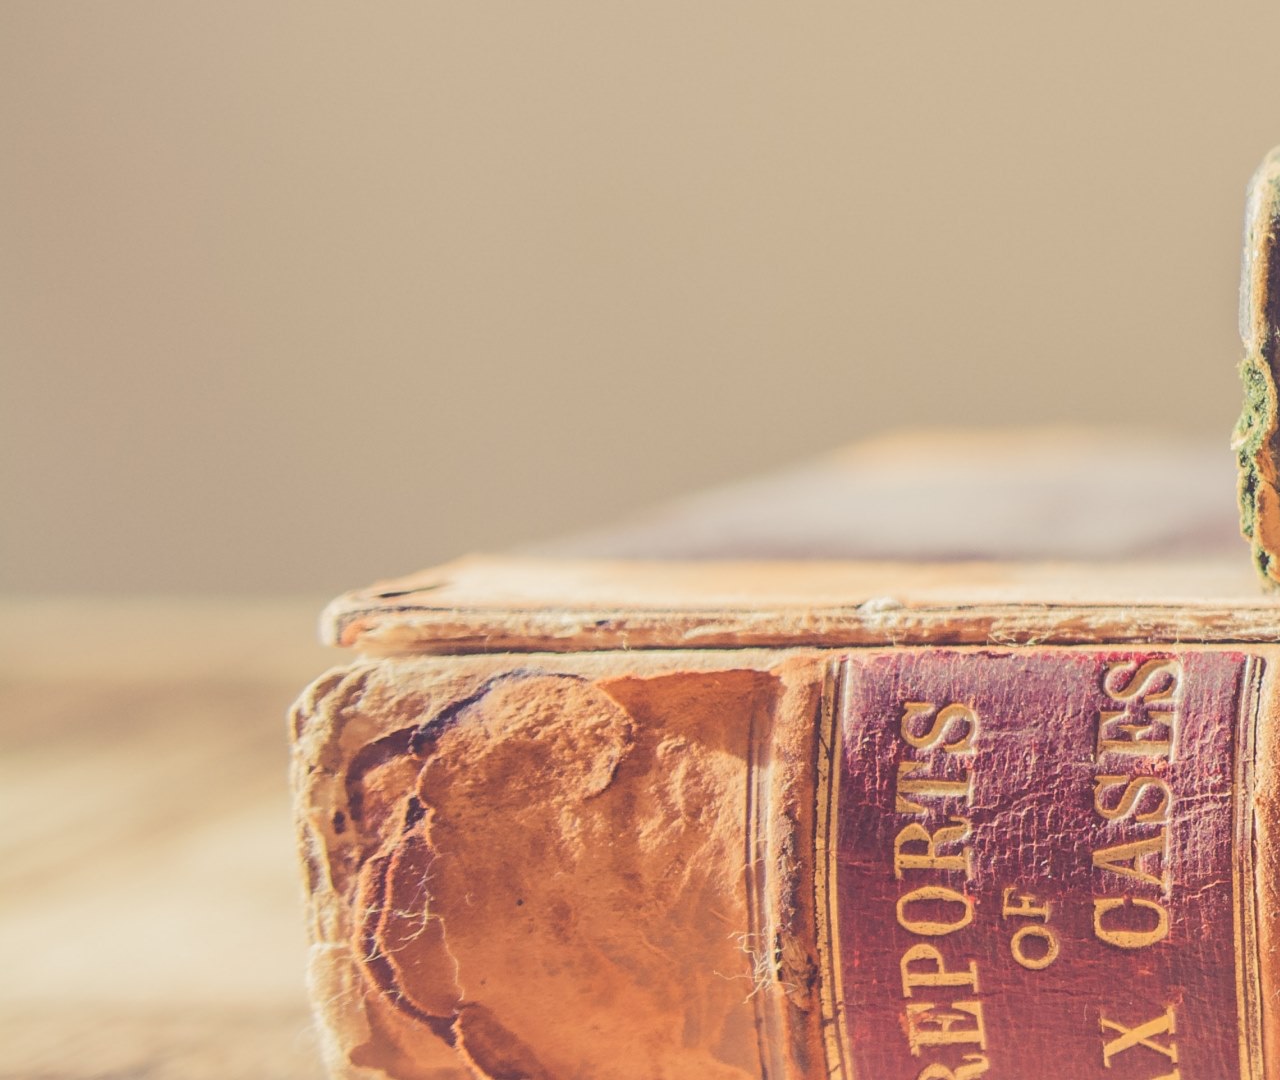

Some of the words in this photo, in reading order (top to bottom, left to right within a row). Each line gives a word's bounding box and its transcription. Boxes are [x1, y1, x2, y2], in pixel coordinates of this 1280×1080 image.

[1092, 659, 1184, 950] CASES
[1002, 886, 1060, 971] OF
[1098, 1005, 1182, 1080] X
